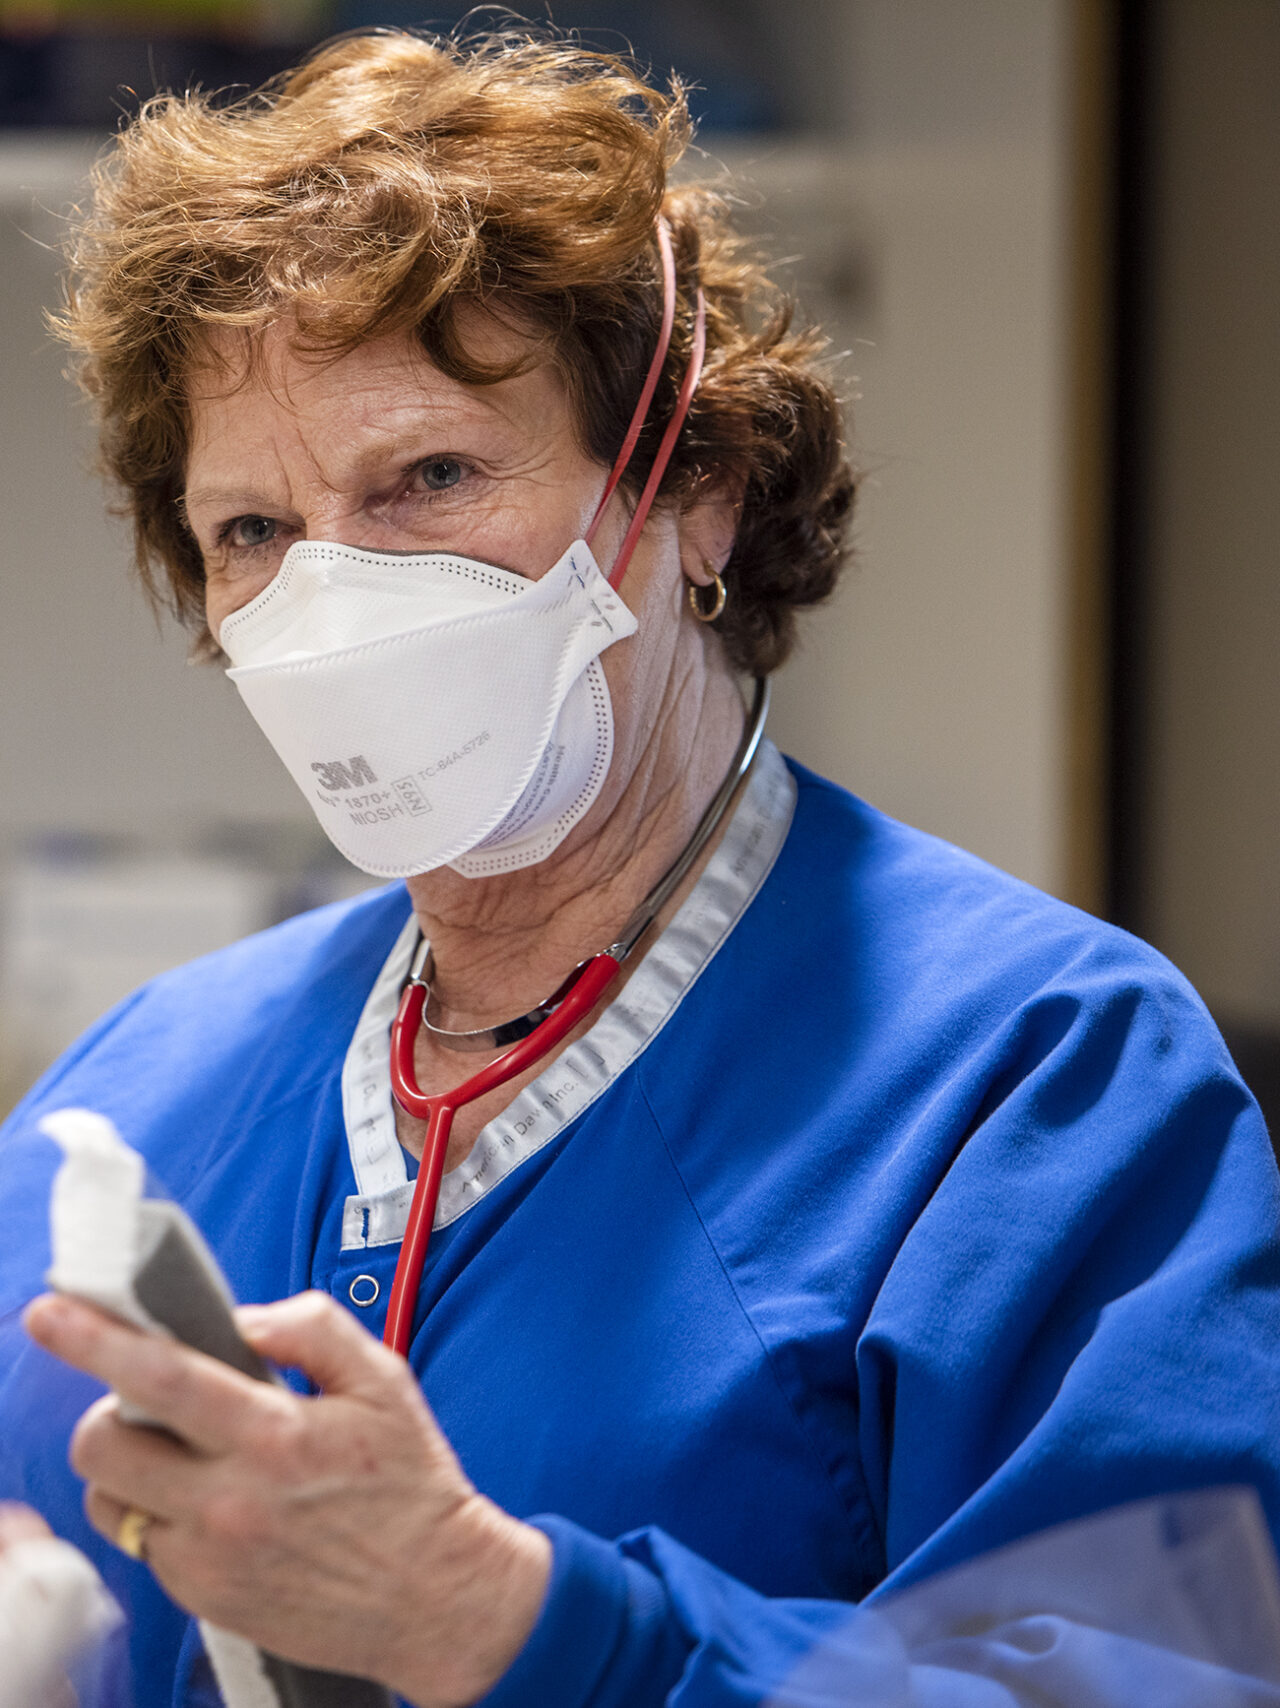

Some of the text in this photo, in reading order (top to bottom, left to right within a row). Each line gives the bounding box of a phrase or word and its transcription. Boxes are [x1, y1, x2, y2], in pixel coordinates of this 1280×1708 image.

[310, 754, 378, 791] 3M
[344, 790, 392, 809] 1870+
[396, 781, 427, 813] N95
[348, 802, 405, 826] NIOSH
